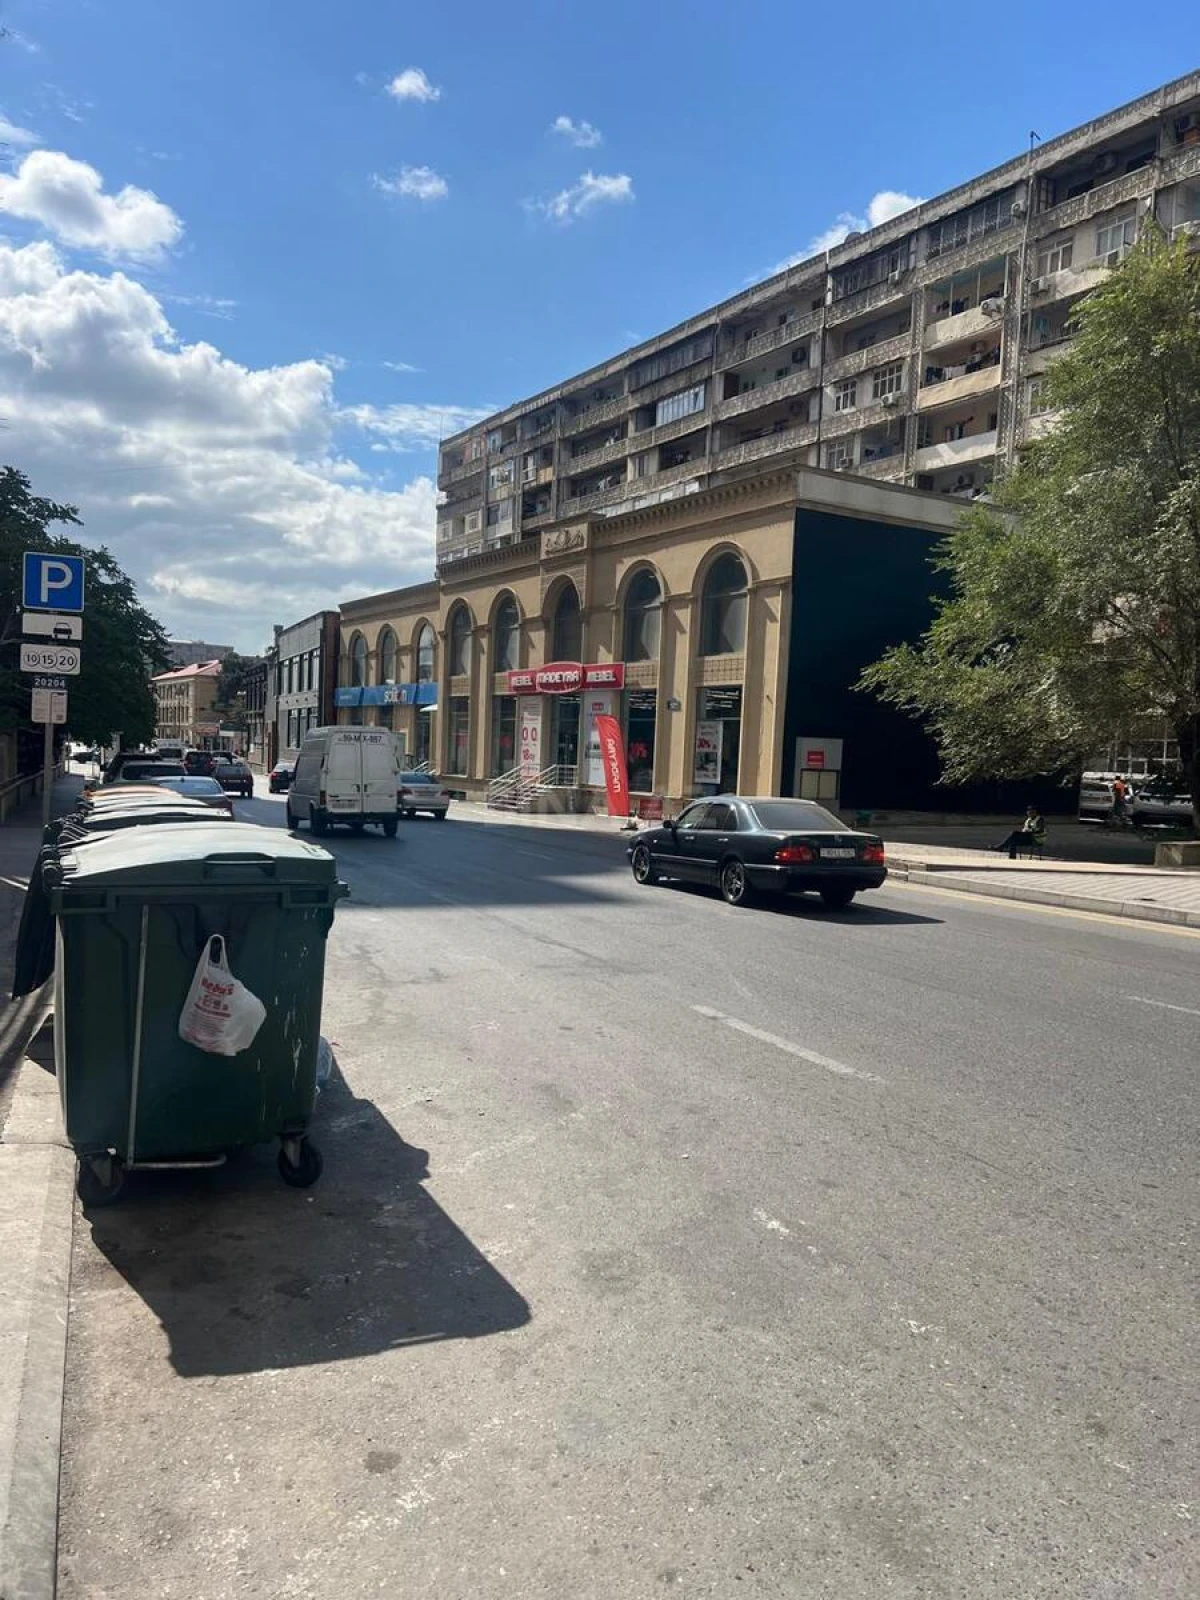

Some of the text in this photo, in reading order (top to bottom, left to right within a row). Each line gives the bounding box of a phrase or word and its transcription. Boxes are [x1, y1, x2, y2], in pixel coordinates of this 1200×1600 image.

[40, 560, 73, 603] P
[26, 653, 74, 666] 10 15 20
